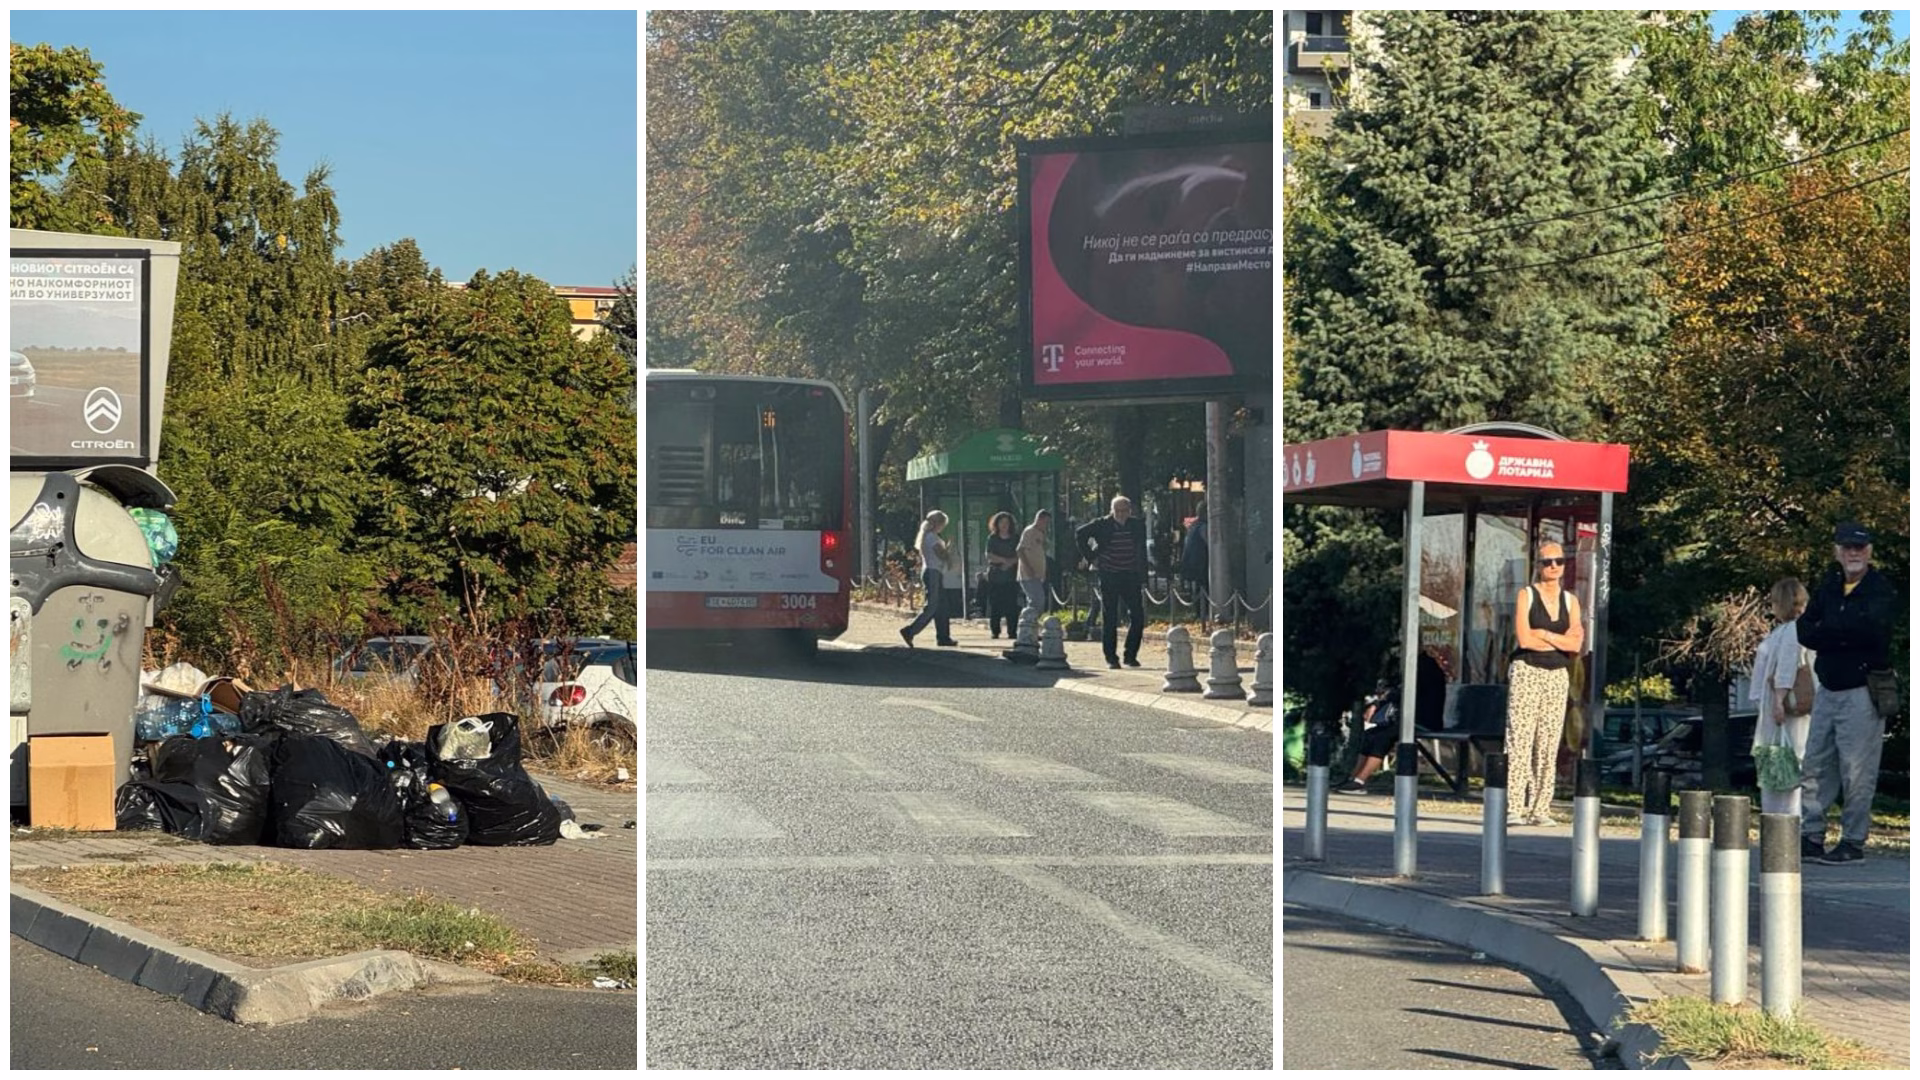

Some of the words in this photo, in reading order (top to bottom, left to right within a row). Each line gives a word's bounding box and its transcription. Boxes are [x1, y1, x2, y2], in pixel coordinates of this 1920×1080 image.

[1083, 233, 1120, 250] Никој
[1122, 235, 1139, 247] не
[1141, 234, 1157, 246] се
[1159, 230, 1190, 248] раѓа
[1193, 231, 1209, 243] со
[1108, 251, 1123, 264] Да
[1125, 253, 1136, 262] ги
[1138, 249, 1196, 262] надминеме
[1198, 249, 1210, 258] за
[1212, 246, 1266, 257] вистински
[11, 262, 63, 273] НОВИОТ
[64, 262, 116, 274] CITROËN
[118, 264, 134, 275] C4
[1186, 259, 1271, 273] #НаправиМесто
[27, 279, 132, 289] НАЈКОМФОРНИОТ
[10, 289, 26, 298] ИЛ
[28, 290, 44, 299] ВО
[47, 290, 132, 299] УНИВЕРЗУМОТ
[1074, 345, 1126, 355] Connecting
[1076, 359, 1094, 368] your
[1097, 356, 1123, 366] world.
[1498, 456, 1554, 469] ДРЖАВНА
[1498, 467, 1554, 478] ЛОТАРИЈА
[701, 536, 716, 545] EU
[701, 546, 725, 555] FOR
[726, 546, 765, 556] CLEAN
[767, 546, 786, 556] AIR
[781, 594, 816, 609] 3004
